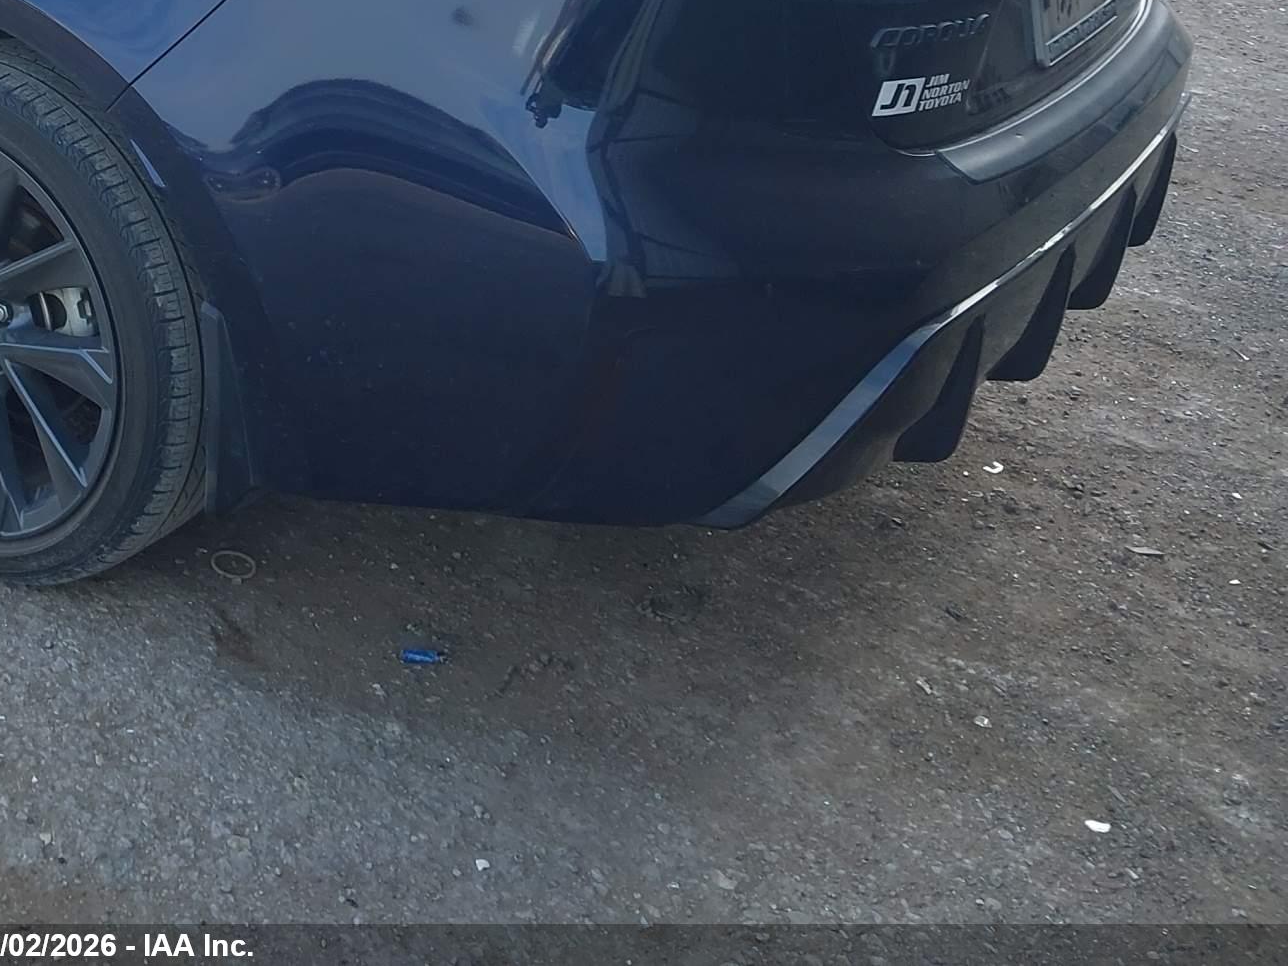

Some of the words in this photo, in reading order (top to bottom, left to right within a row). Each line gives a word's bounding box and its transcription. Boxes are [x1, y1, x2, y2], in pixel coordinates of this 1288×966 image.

[921, 79, 970, 100] NORTON
[925, 73, 950, 88] JIM
[918, 92, 962, 112] TOYOTA
